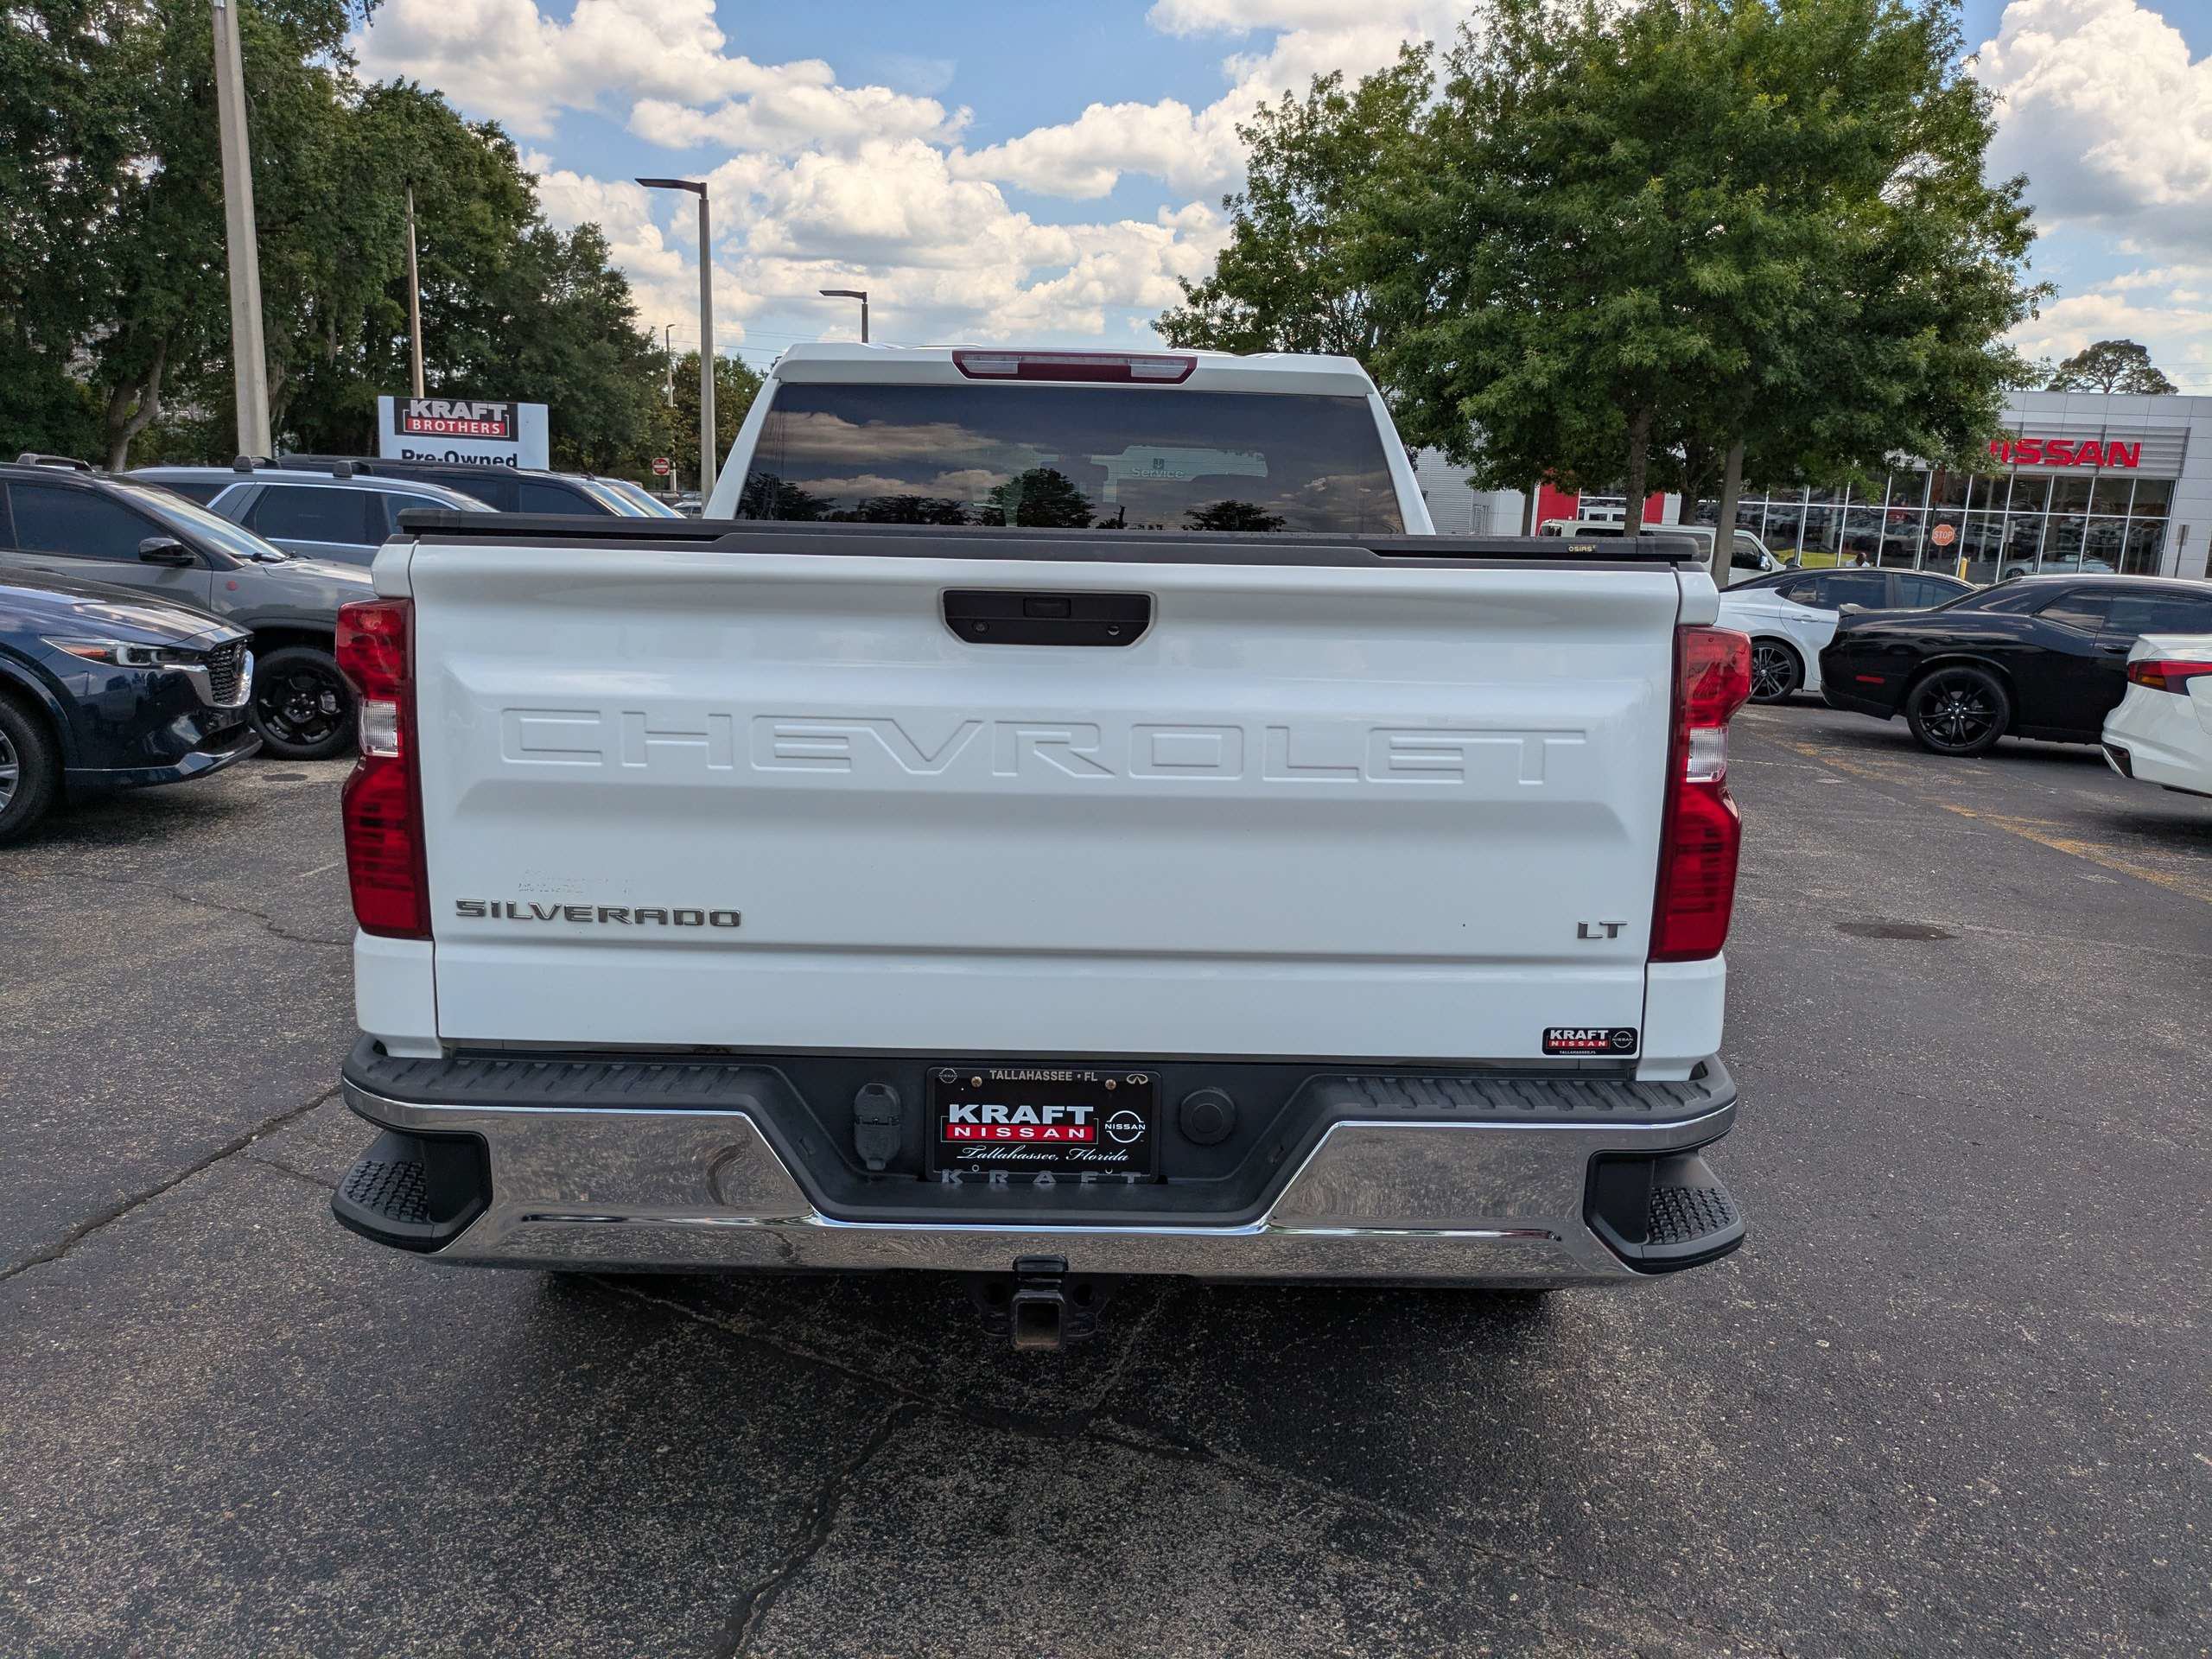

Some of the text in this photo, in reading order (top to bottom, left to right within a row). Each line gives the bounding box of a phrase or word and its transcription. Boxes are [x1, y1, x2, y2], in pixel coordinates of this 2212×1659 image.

[410, 400, 508, 421] KRAFT
[412, 419, 501, 435] BROTHERS
[402, 449, 518, 467] Pre-Owned
[1133, 467, 1184, 478] Service
[1934, 531, 1953, 539] STOP
[501, 708, 1587, 785] CHEVROLET
[455, 899, 741, 927] SILVERADO
[1577, 921, 1628, 939] LT
[1550, 1029, 1609, 1040] KRAFT
[989, 1070, 1098, 1082] TALLAHASSEE FL
[949, 1103, 1094, 1125] KRAFT
[954, 1127, 1085, 1139] NISSAN
[957, 1144, 1129, 1161] Tallahassee, Florida
[942, 1168, 1141, 1185] KRAFT
